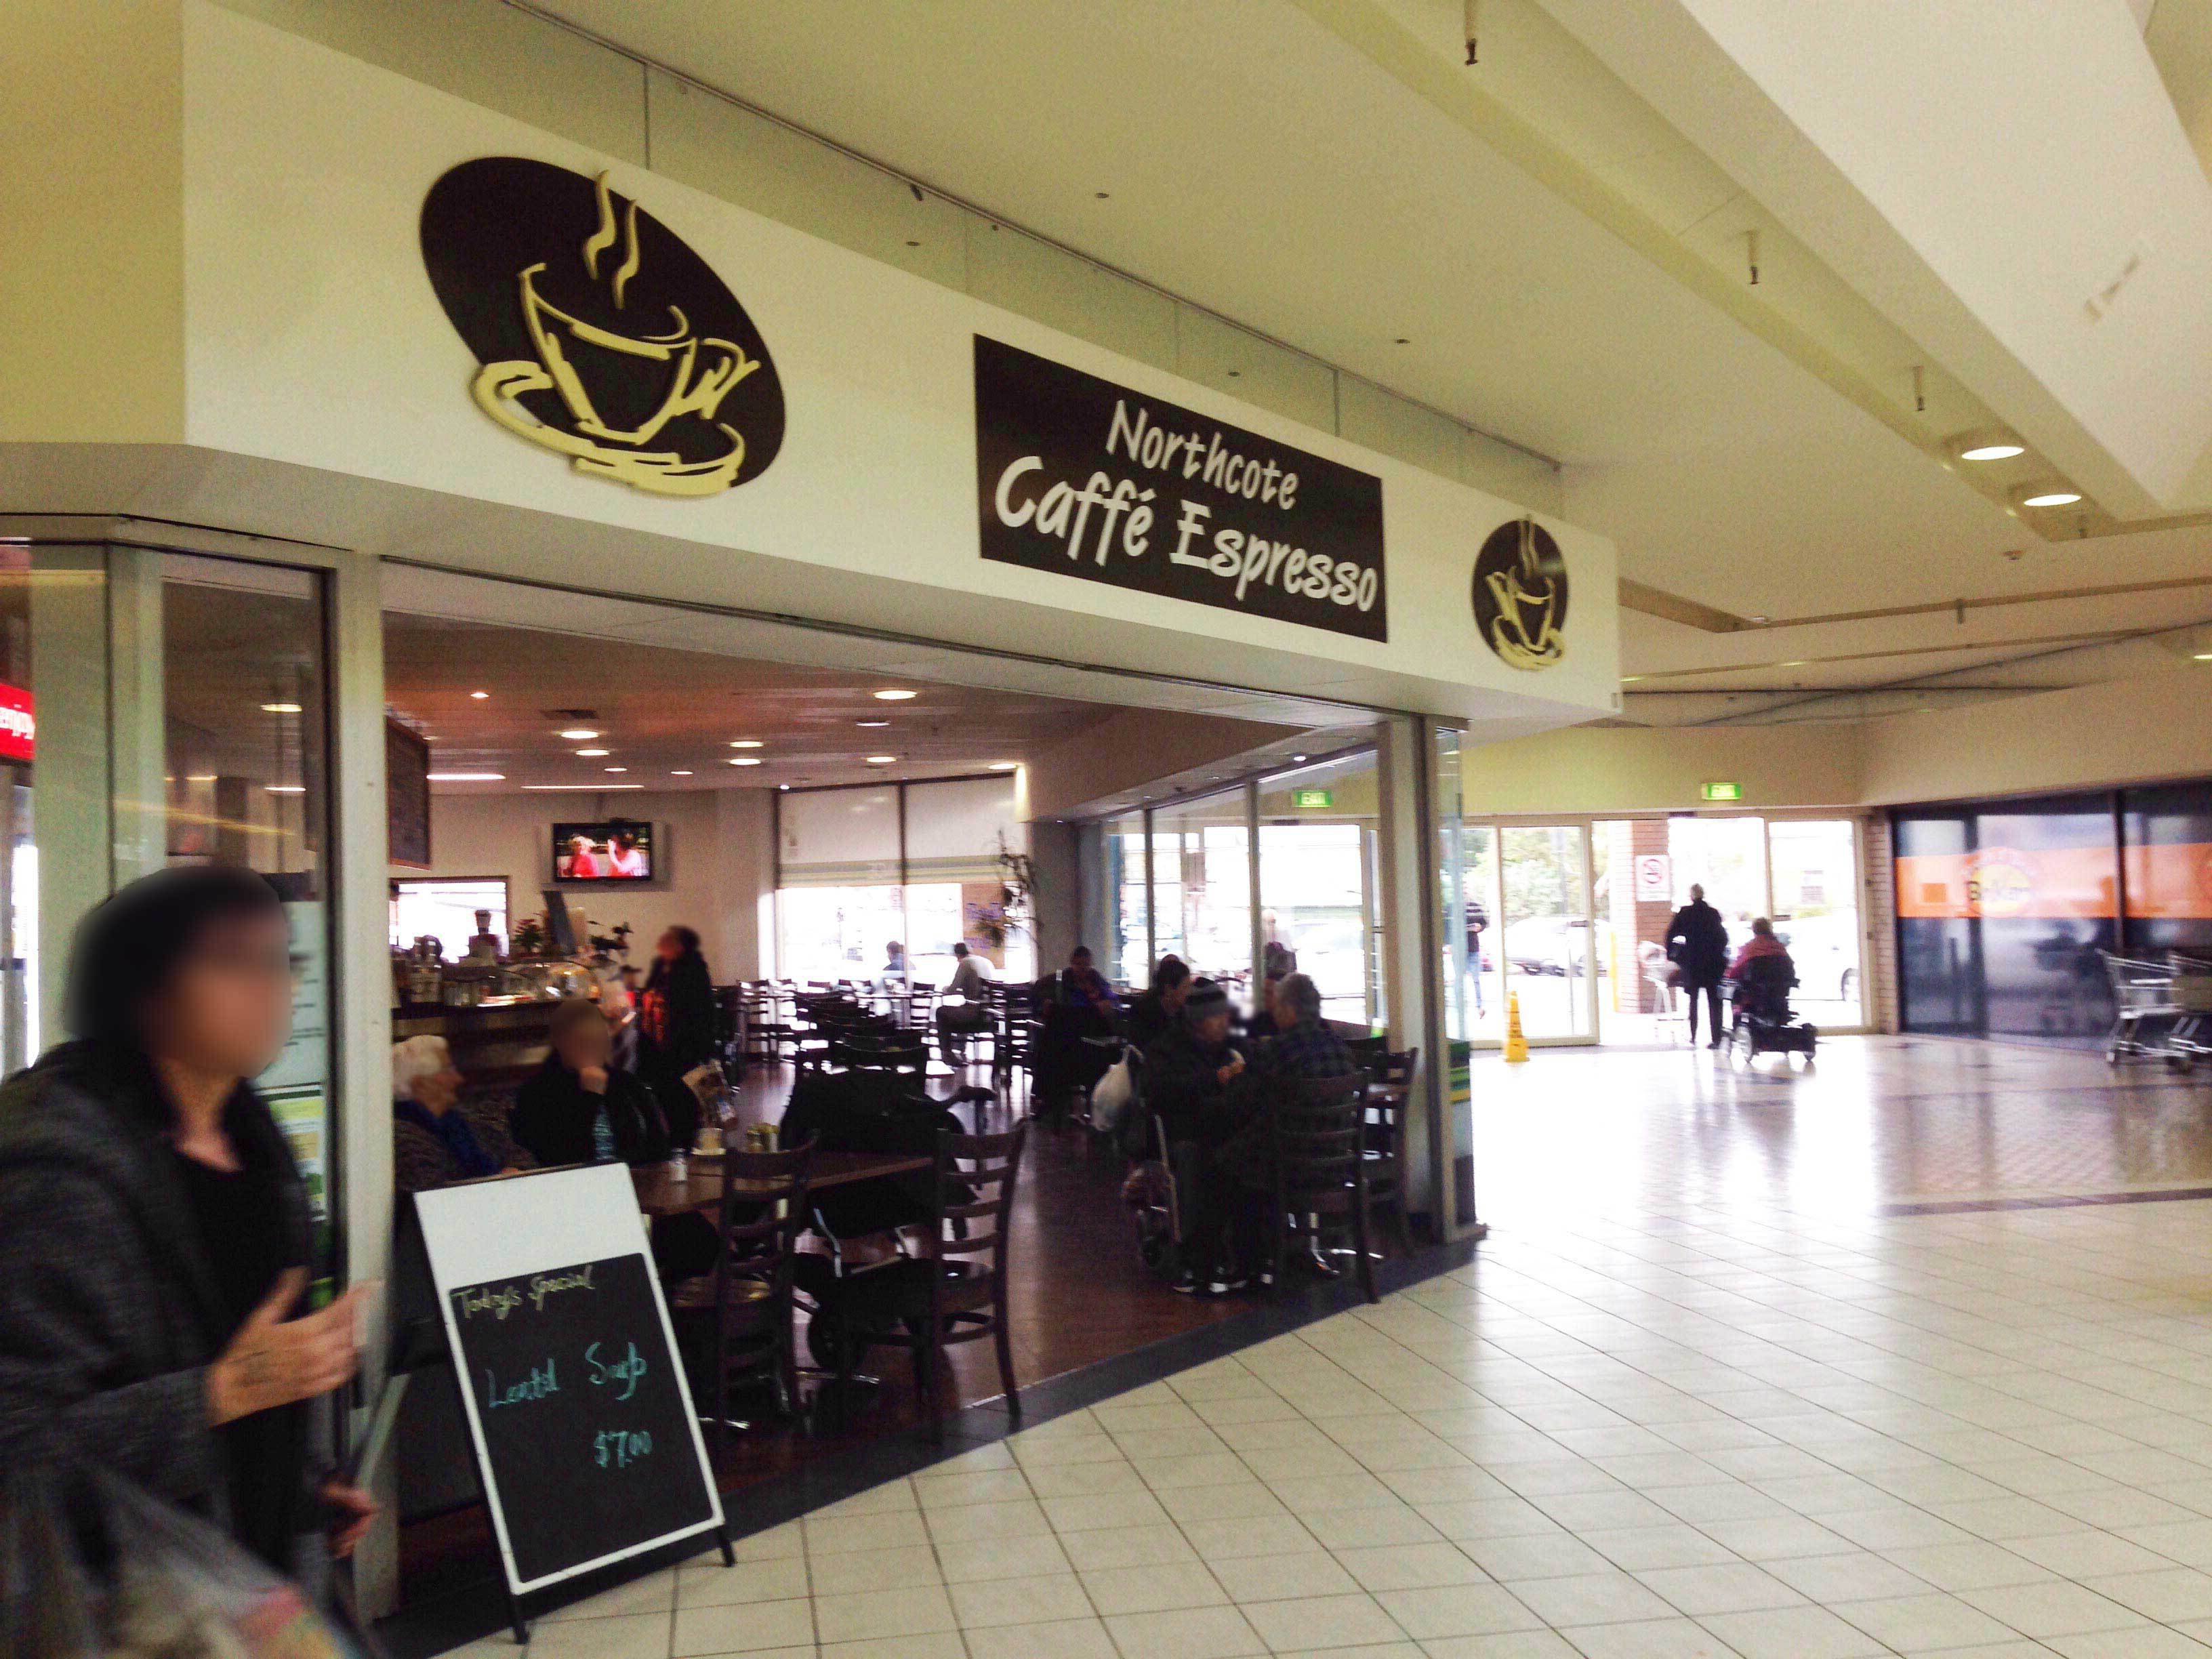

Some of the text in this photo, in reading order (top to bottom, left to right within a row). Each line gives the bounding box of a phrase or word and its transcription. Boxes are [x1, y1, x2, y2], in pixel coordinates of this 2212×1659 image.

[1105, 399, 1299, 510] Northcote
[995, 455, 1378, 611] Caffé Espresso
